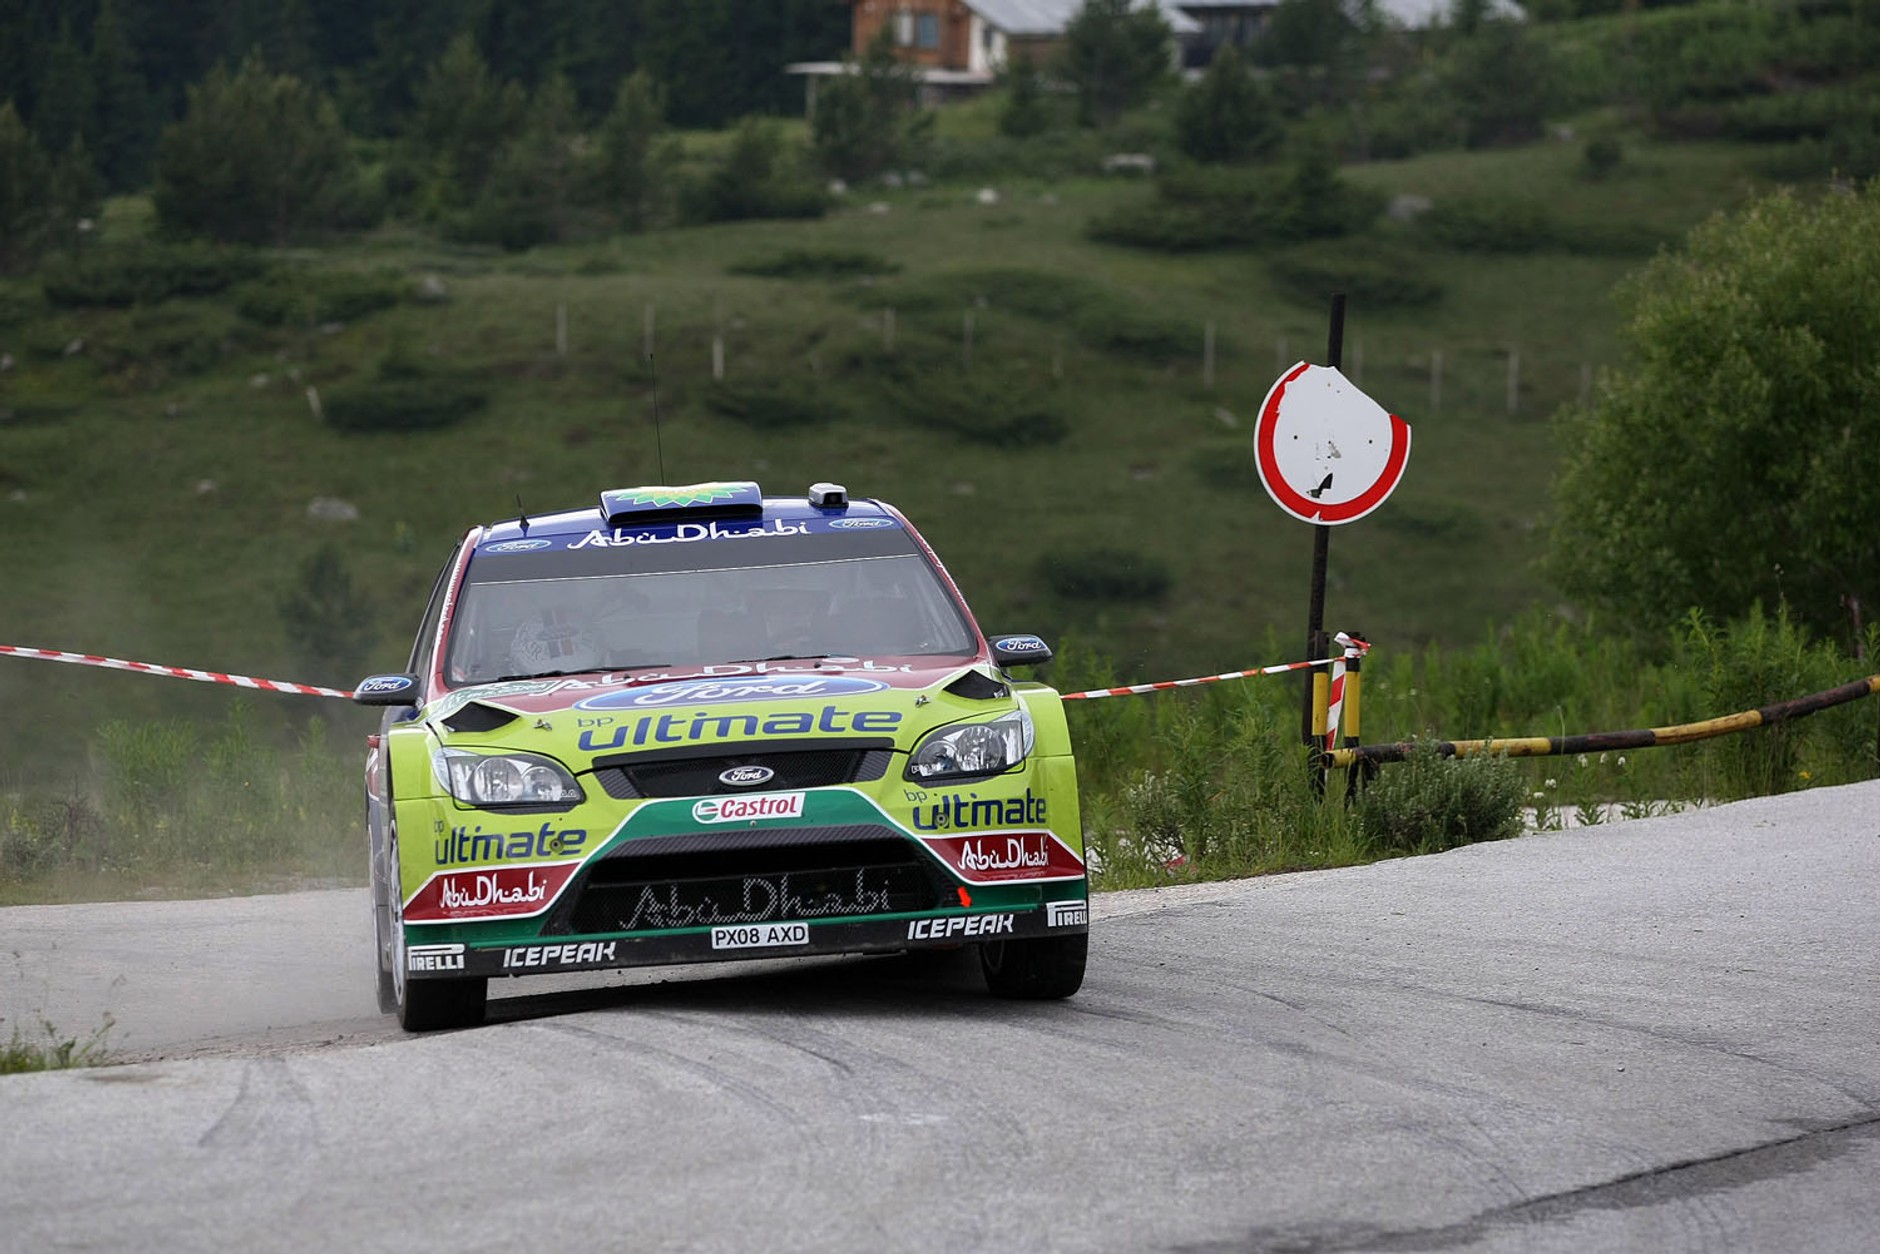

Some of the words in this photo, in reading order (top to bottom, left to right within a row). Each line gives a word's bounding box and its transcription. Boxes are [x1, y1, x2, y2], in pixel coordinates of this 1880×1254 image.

[1007, 641, 1041, 651] Ford
[364, 680, 402, 691] Ford
[634, 680, 827, 705] Ford
[577, 716, 614, 727] bp
[578, 706, 903, 751] ultimate
[720, 796, 797, 818] Castrol
[903, 789, 928, 802] bp
[913, 788, 1047, 830] ultimate
[435, 822, 587, 865] ultimate
[715, 928, 760, 946] PX08
[767, 925, 806, 944] AXD
[908, 914, 1014, 940] ICEPEAK
[408, 943, 465, 971] PIRELLI
[503, 942, 616, 968] ICEPEAK
